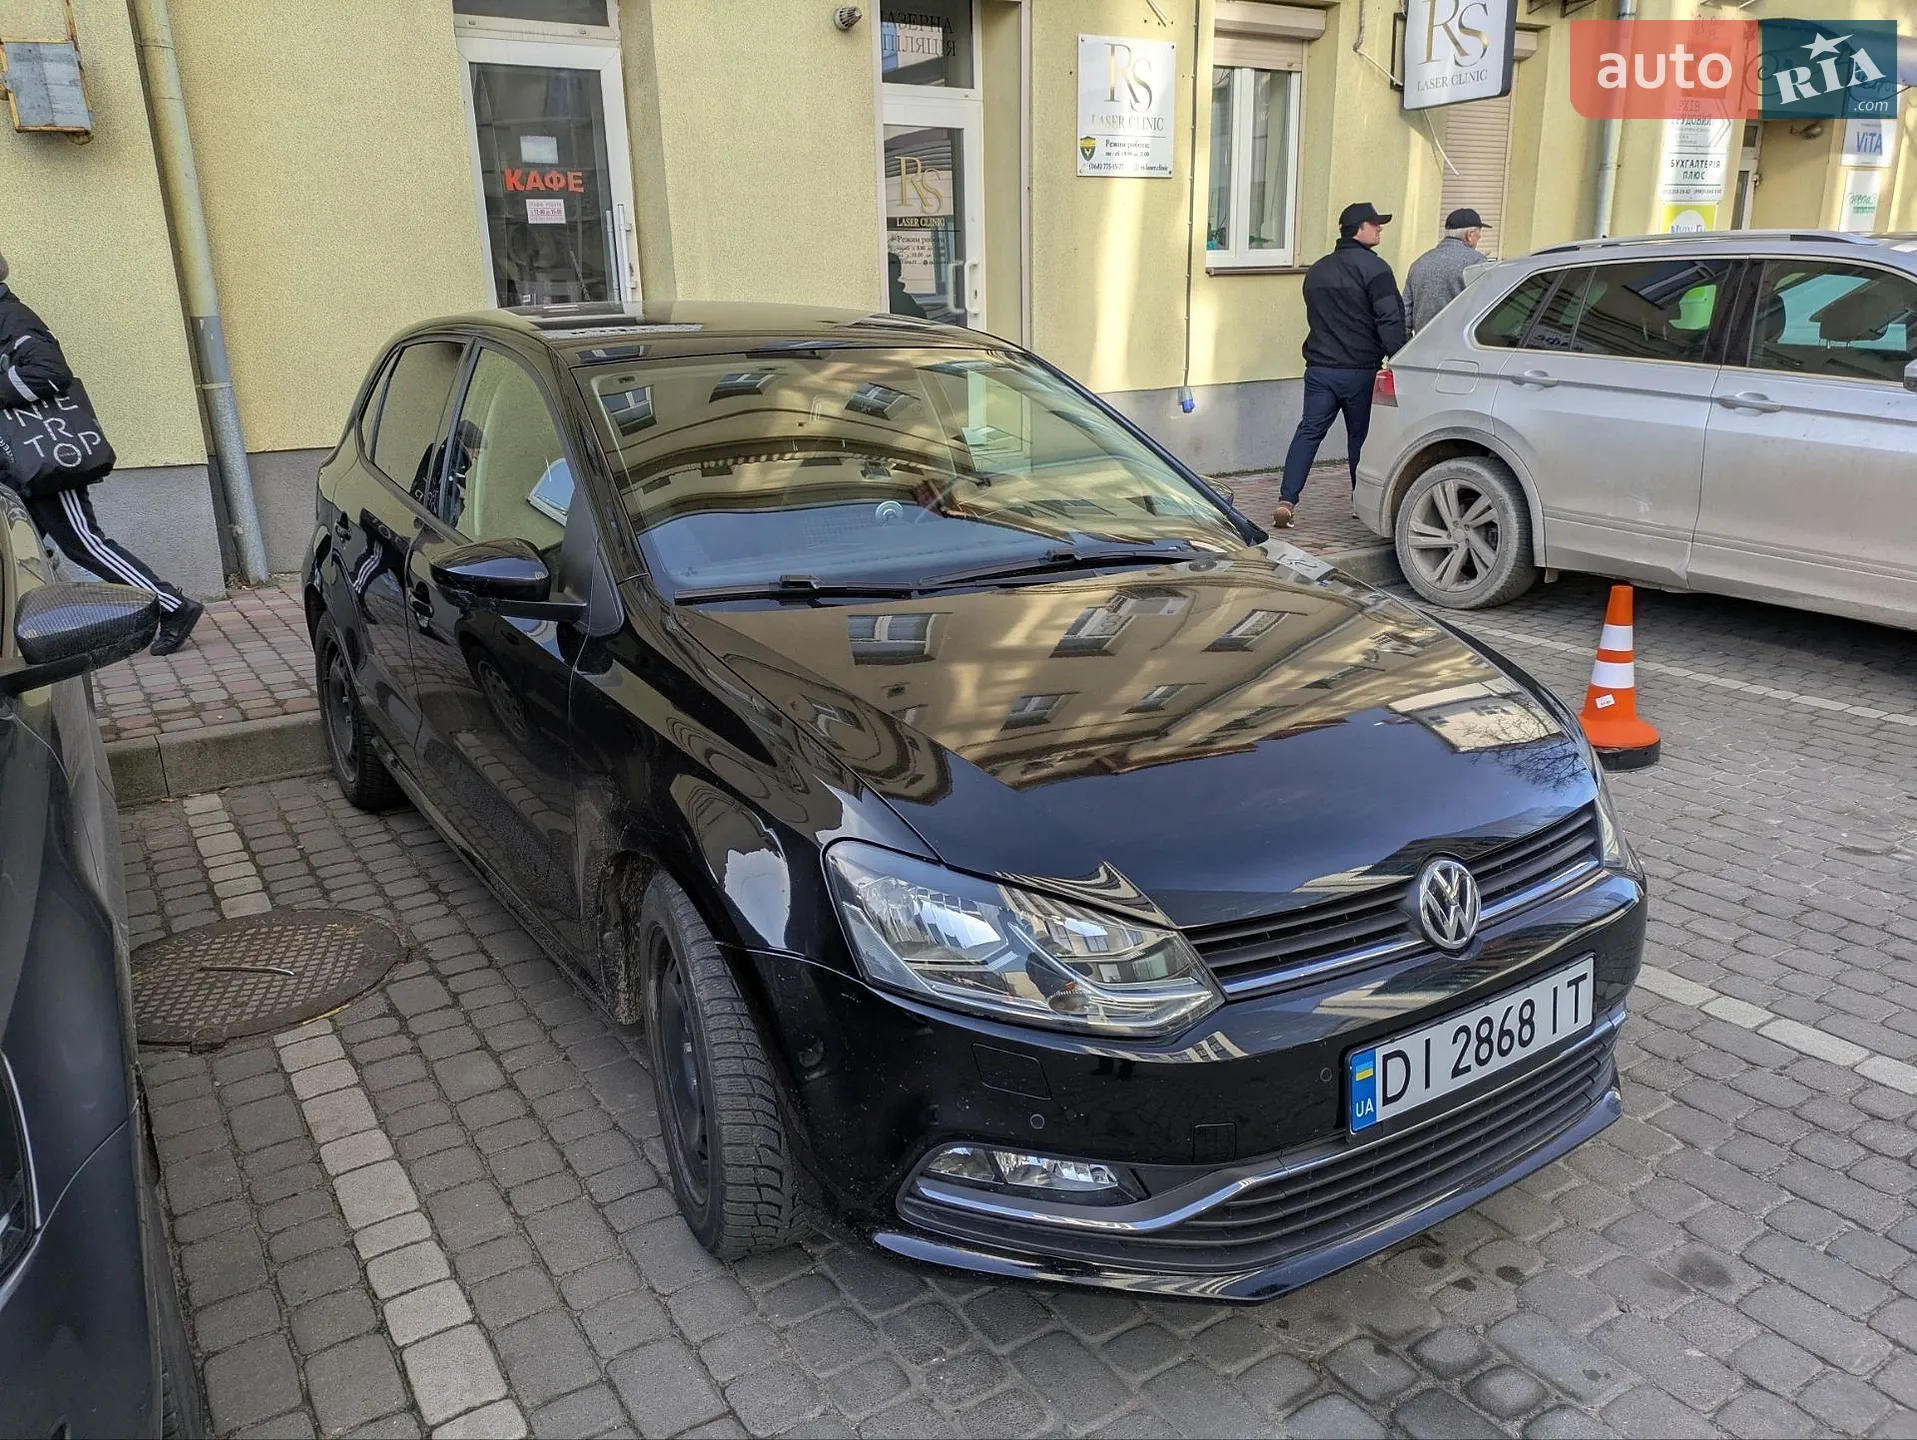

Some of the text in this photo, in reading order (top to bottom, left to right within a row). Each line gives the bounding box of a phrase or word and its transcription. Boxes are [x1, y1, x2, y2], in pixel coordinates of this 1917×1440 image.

[880, 9, 954, 34] АЗЕРНА
[1418, 0, 1489, 68] RS
[1417, 69, 1488, 92] LASER CLINIC
[1090, 114, 1165, 131] LASER CLINIC
[1670, 159, 1721, 169] БУХГАЛТЕРІЯ
[1682, 171, 1706, 180] ПЛЮС
[504, 168, 584, 193] КАФЕ
[895, 156, 944, 215] RS
[896, 217, 920, 228] LASER
[24, 431, 101, 468] TOP
[1381, 972, 1588, 1107] DI 2868 IT
[1355, 1098, 1374, 1118] UA
